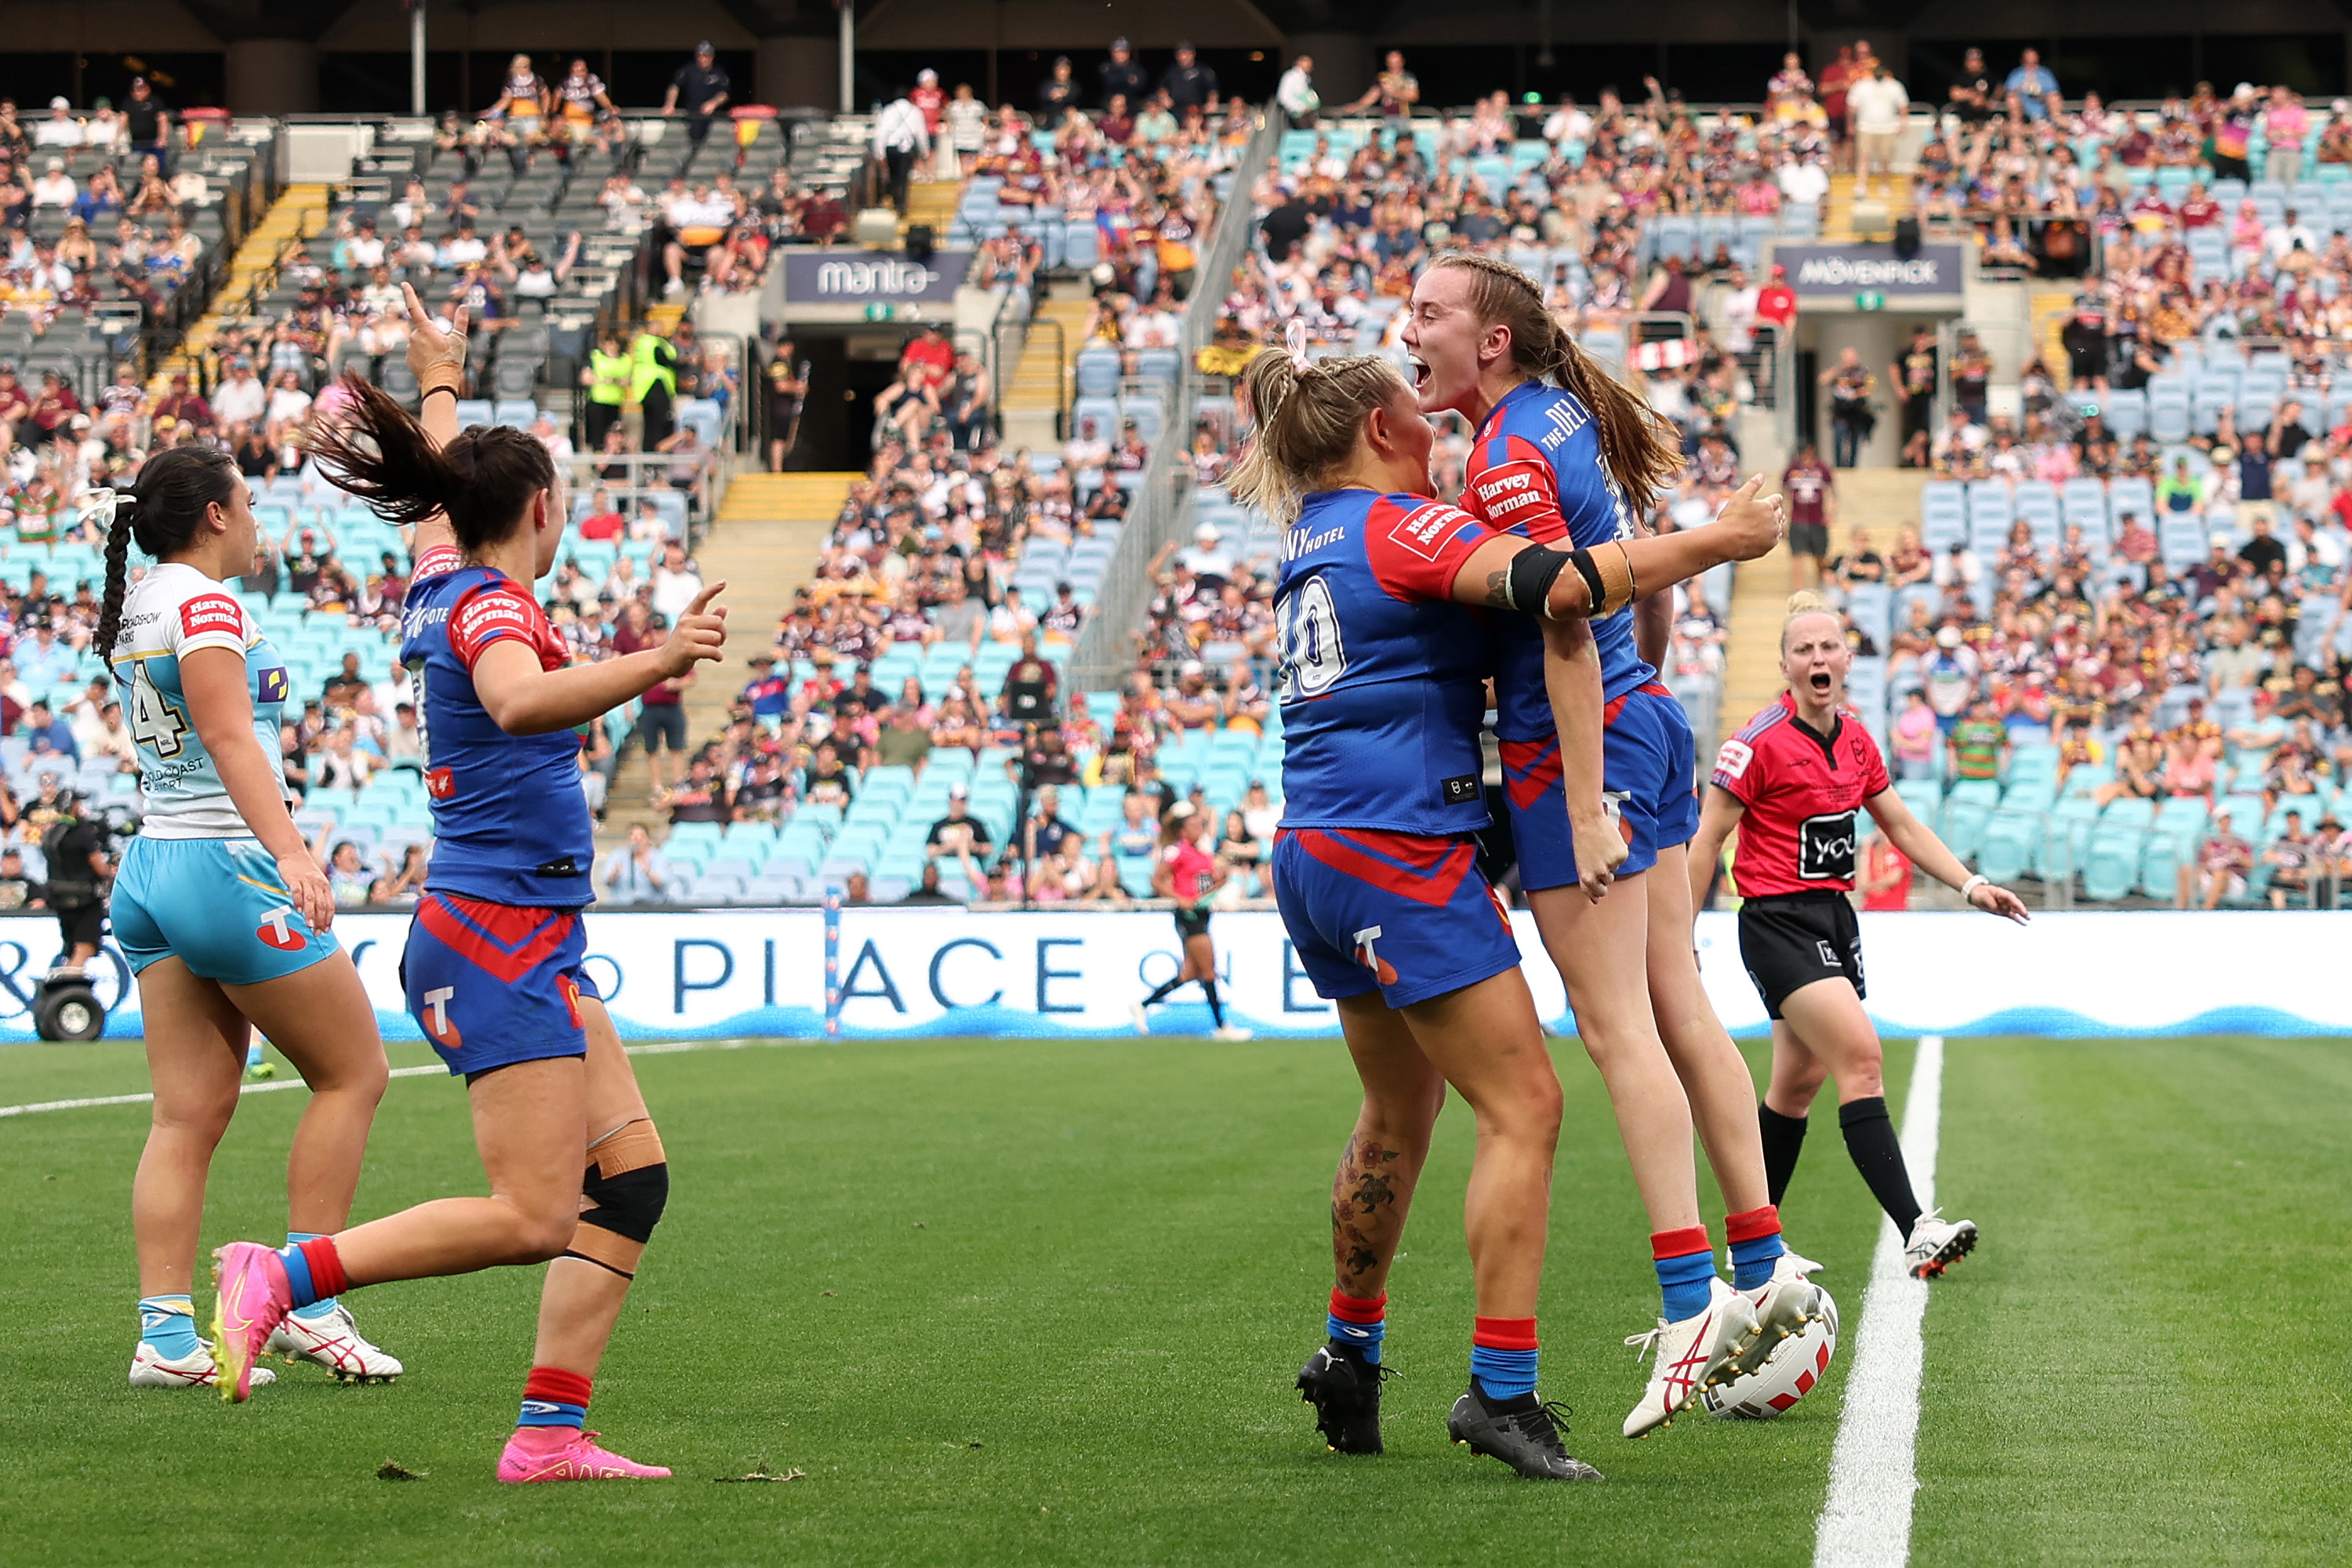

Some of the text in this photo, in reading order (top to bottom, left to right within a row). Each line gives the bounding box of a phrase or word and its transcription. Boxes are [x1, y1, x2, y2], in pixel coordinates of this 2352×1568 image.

[817, 258, 941, 295] mantra
[1541, 427, 1566, 452] THE
[1478, 473, 1531, 503] Harvey
[1484, 490, 1541, 520] Norman
[1305, 526, 1345, 555] HOTEL
[190, 599, 236, 615] Harvey
[190, 612, 239, 629] Norman
[131, 659, 191, 760] 4
[164, 757, 204, 778] COAST
[260, 904, 292, 945] T
[1352, 924, 1382, 972] T
[423, 985, 454, 1036] T
